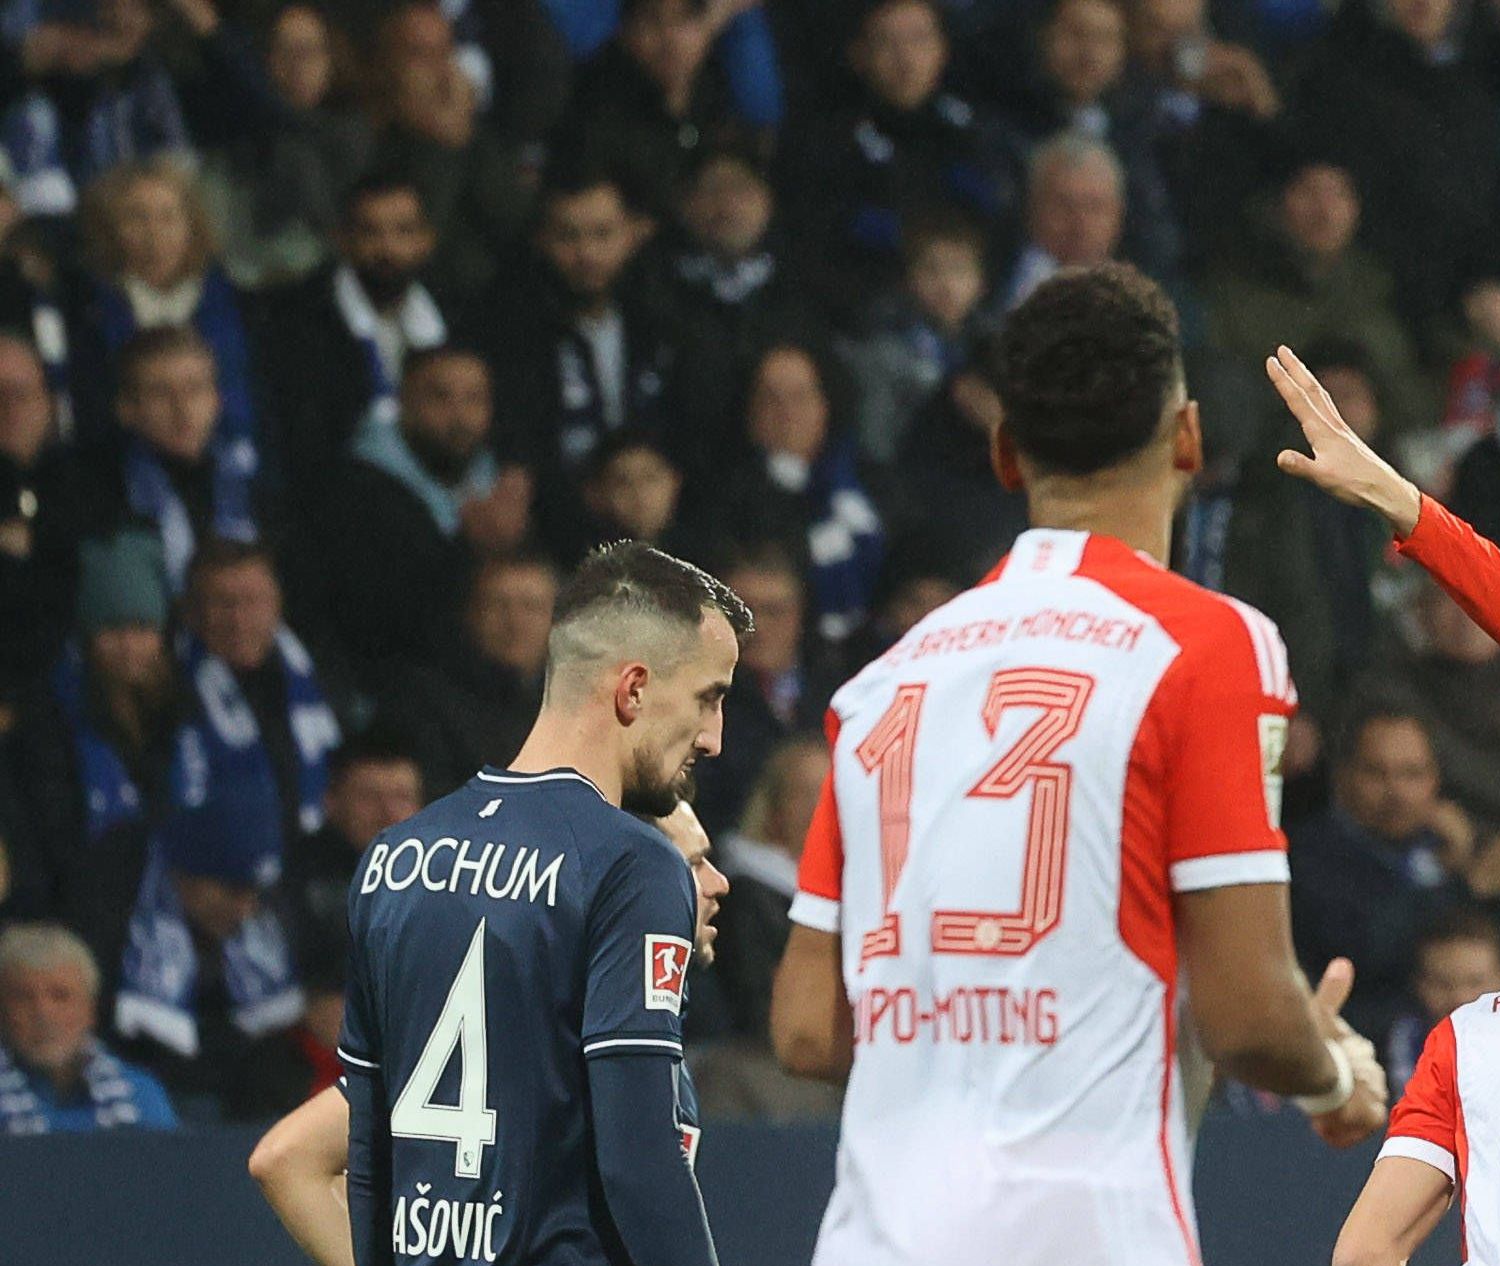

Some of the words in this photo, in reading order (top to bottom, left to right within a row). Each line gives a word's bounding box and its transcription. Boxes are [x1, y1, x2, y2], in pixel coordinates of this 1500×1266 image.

[1013, 608, 1145, 652] MÜNCHEN
[361, 837, 565, 907] BOCHUM
[854, 667, 1096, 976] 13
[390, 917, 497, 1179] 4
